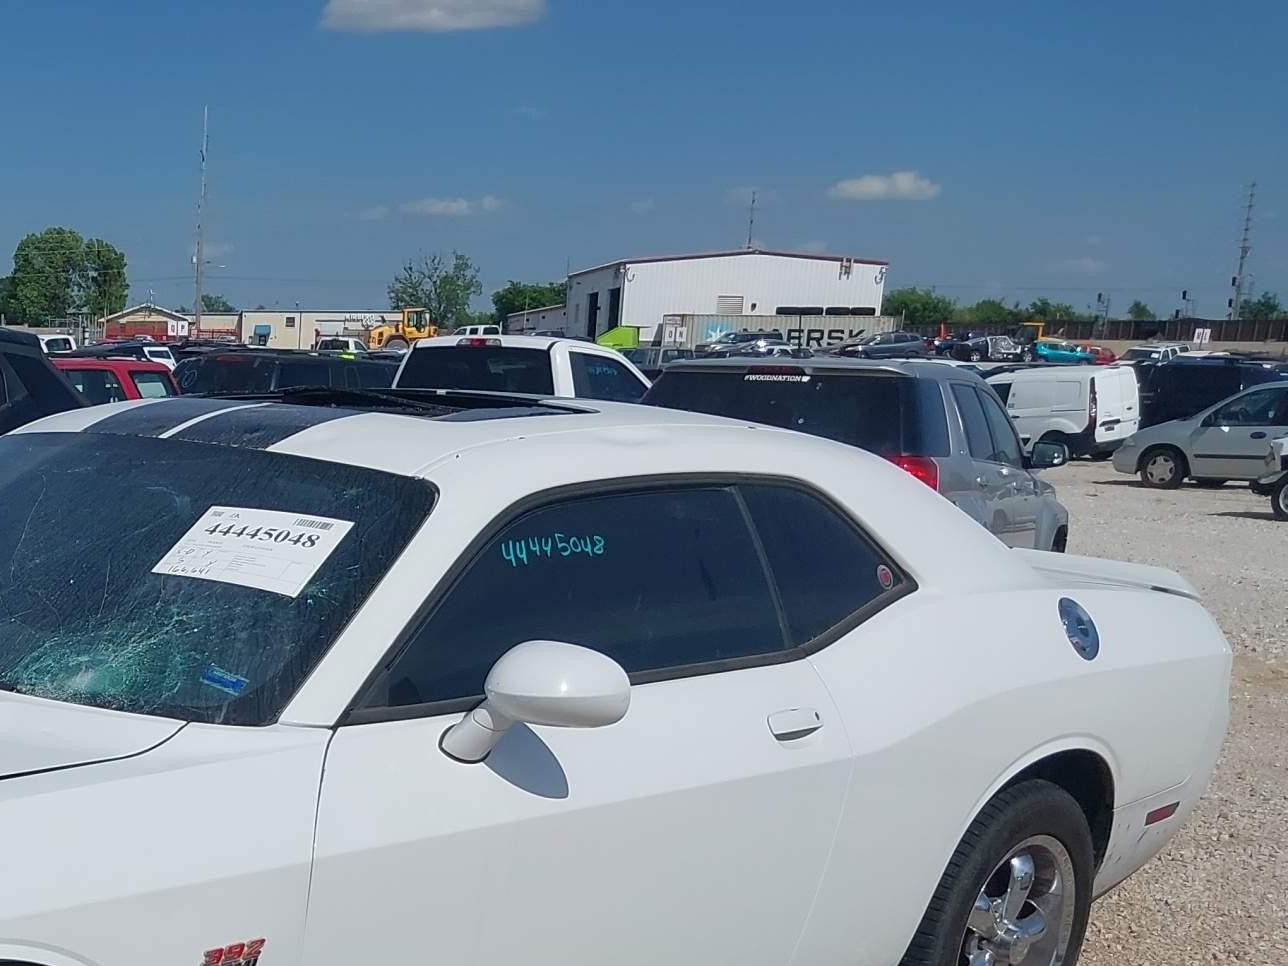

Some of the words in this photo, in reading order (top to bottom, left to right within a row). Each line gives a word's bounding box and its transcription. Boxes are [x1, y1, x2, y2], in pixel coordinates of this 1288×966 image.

[204, 522, 321, 549] 44445048
[501, 533, 605, 567] 44445048
[203, 938, 266, 966] 392
